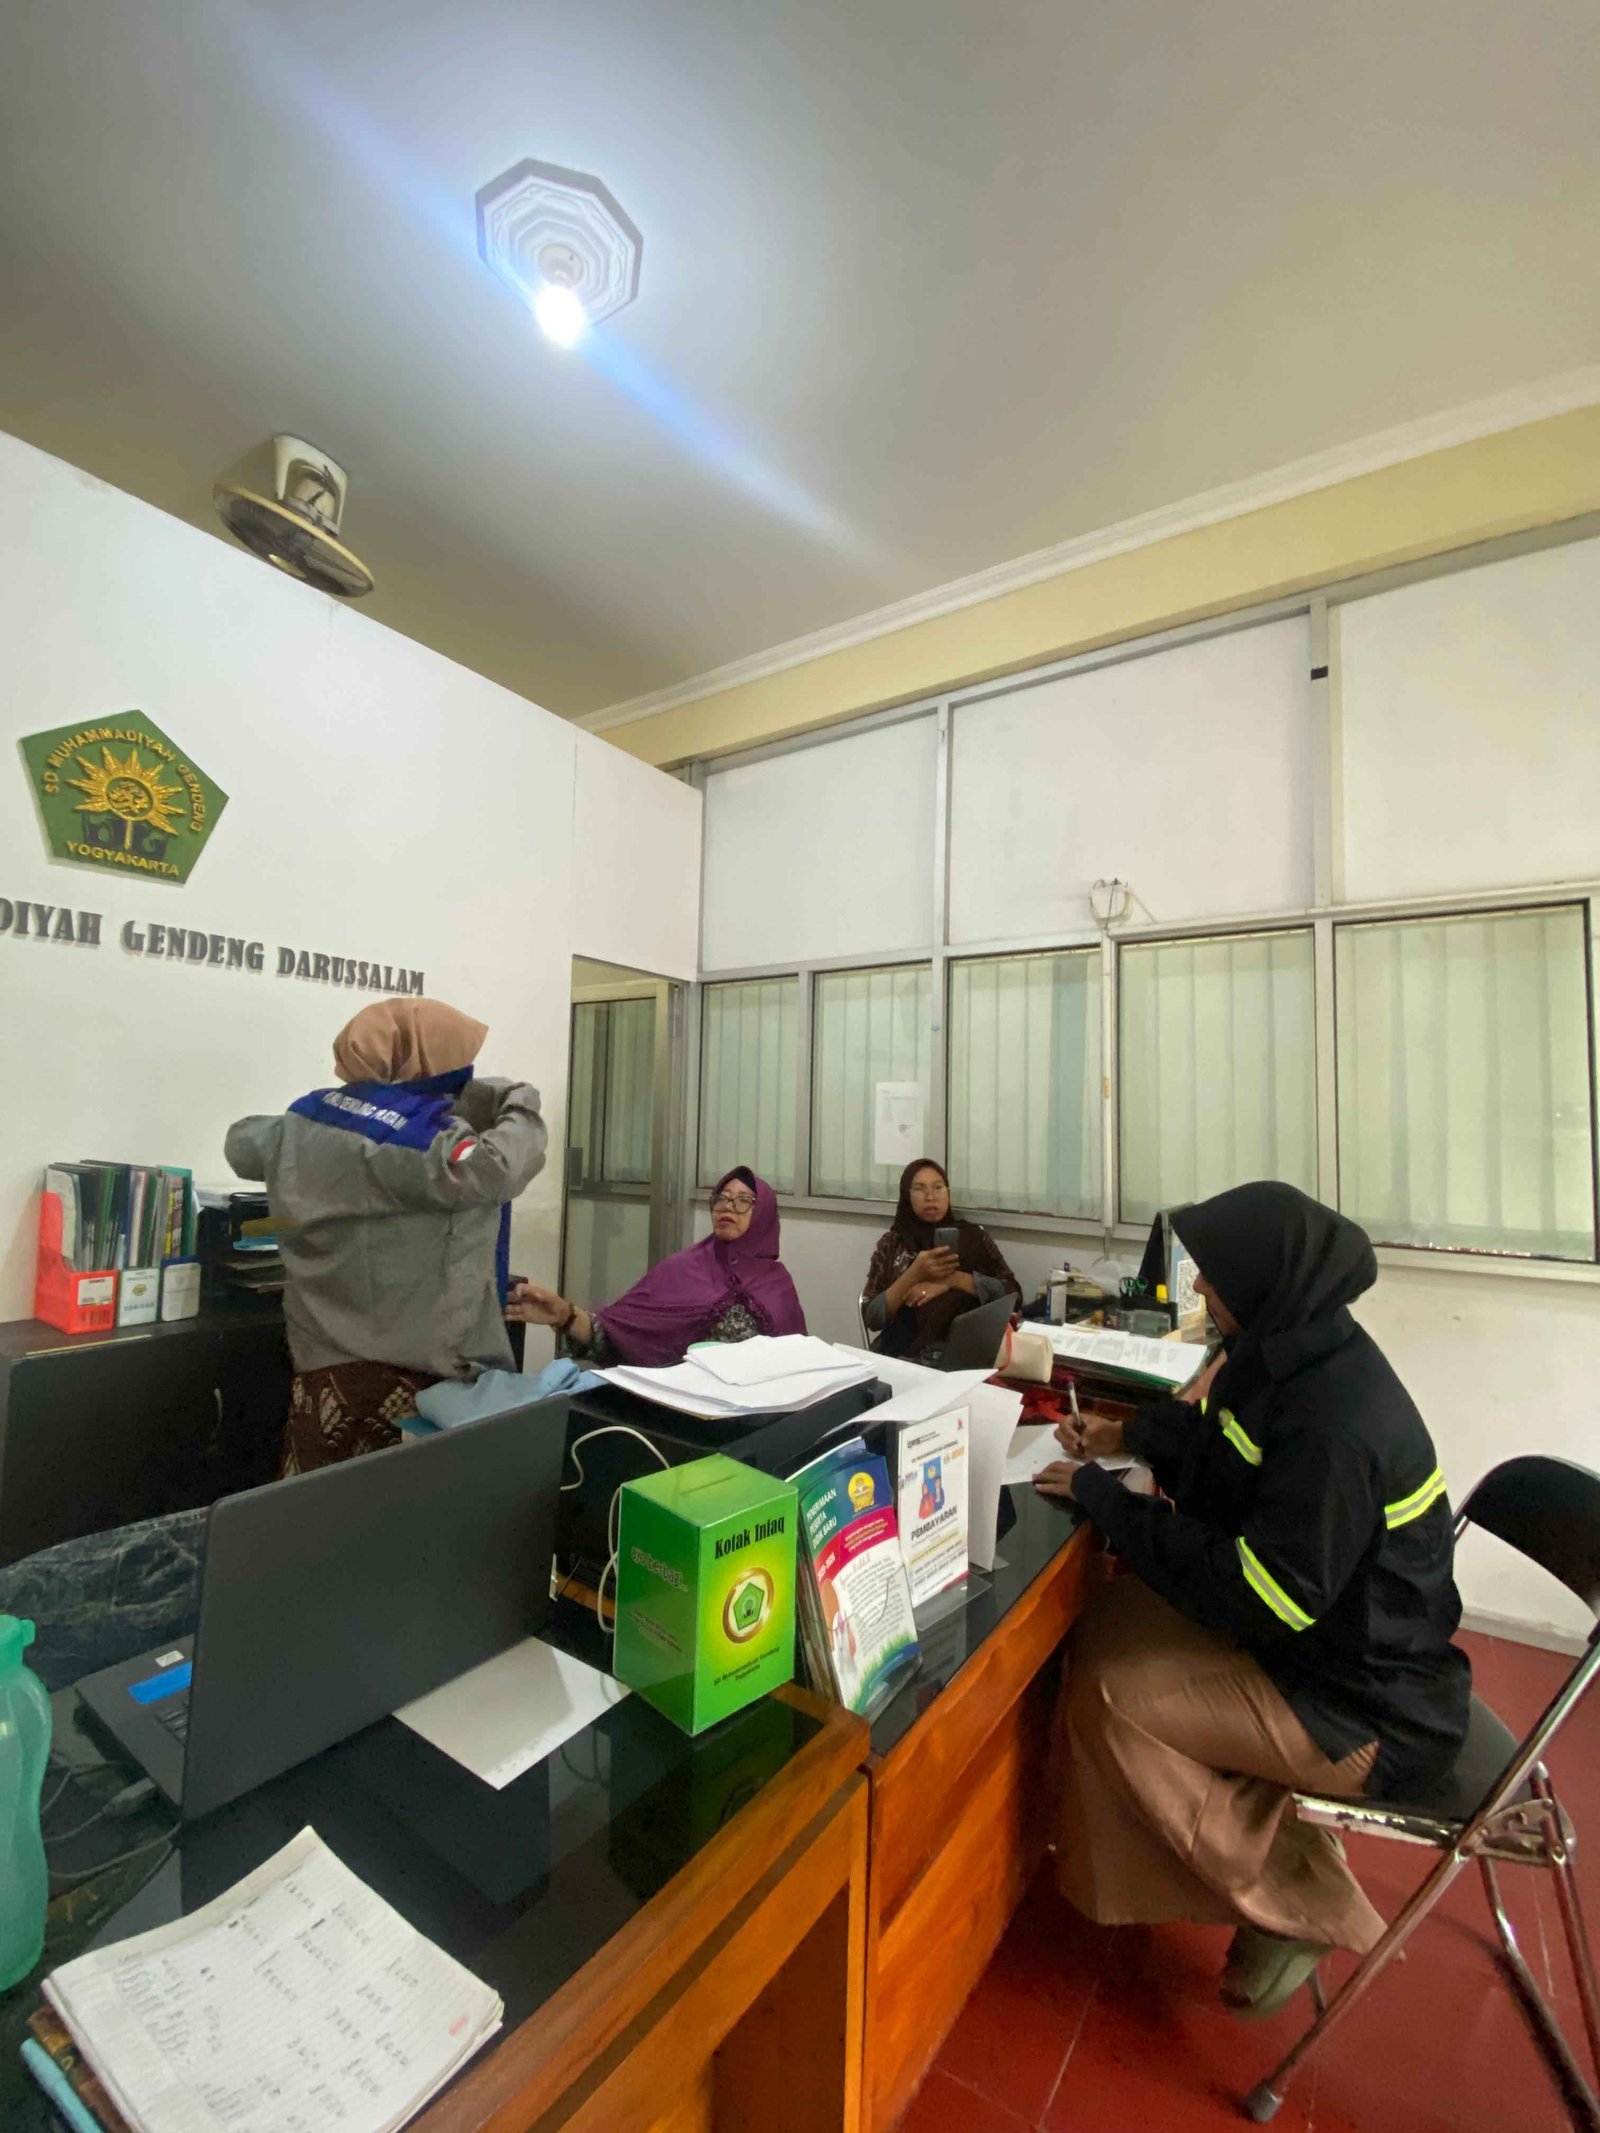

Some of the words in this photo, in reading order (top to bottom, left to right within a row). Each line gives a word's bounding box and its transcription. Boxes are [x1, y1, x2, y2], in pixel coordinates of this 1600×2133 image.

[47, 728, 176, 768] MUHAMMADIYAH
[44, 771, 60, 794] SD
[177, 764, 207, 832] GENDENG
[66, 840, 180, 876] YOGYAKARTA
[122, 919, 264, 971] GENDENG
[277, 946, 425, 996] DARUSSALAM
[911, 1504, 958, 1541] PEMBAYARAN
[714, 1528, 751, 1560] Kotak
